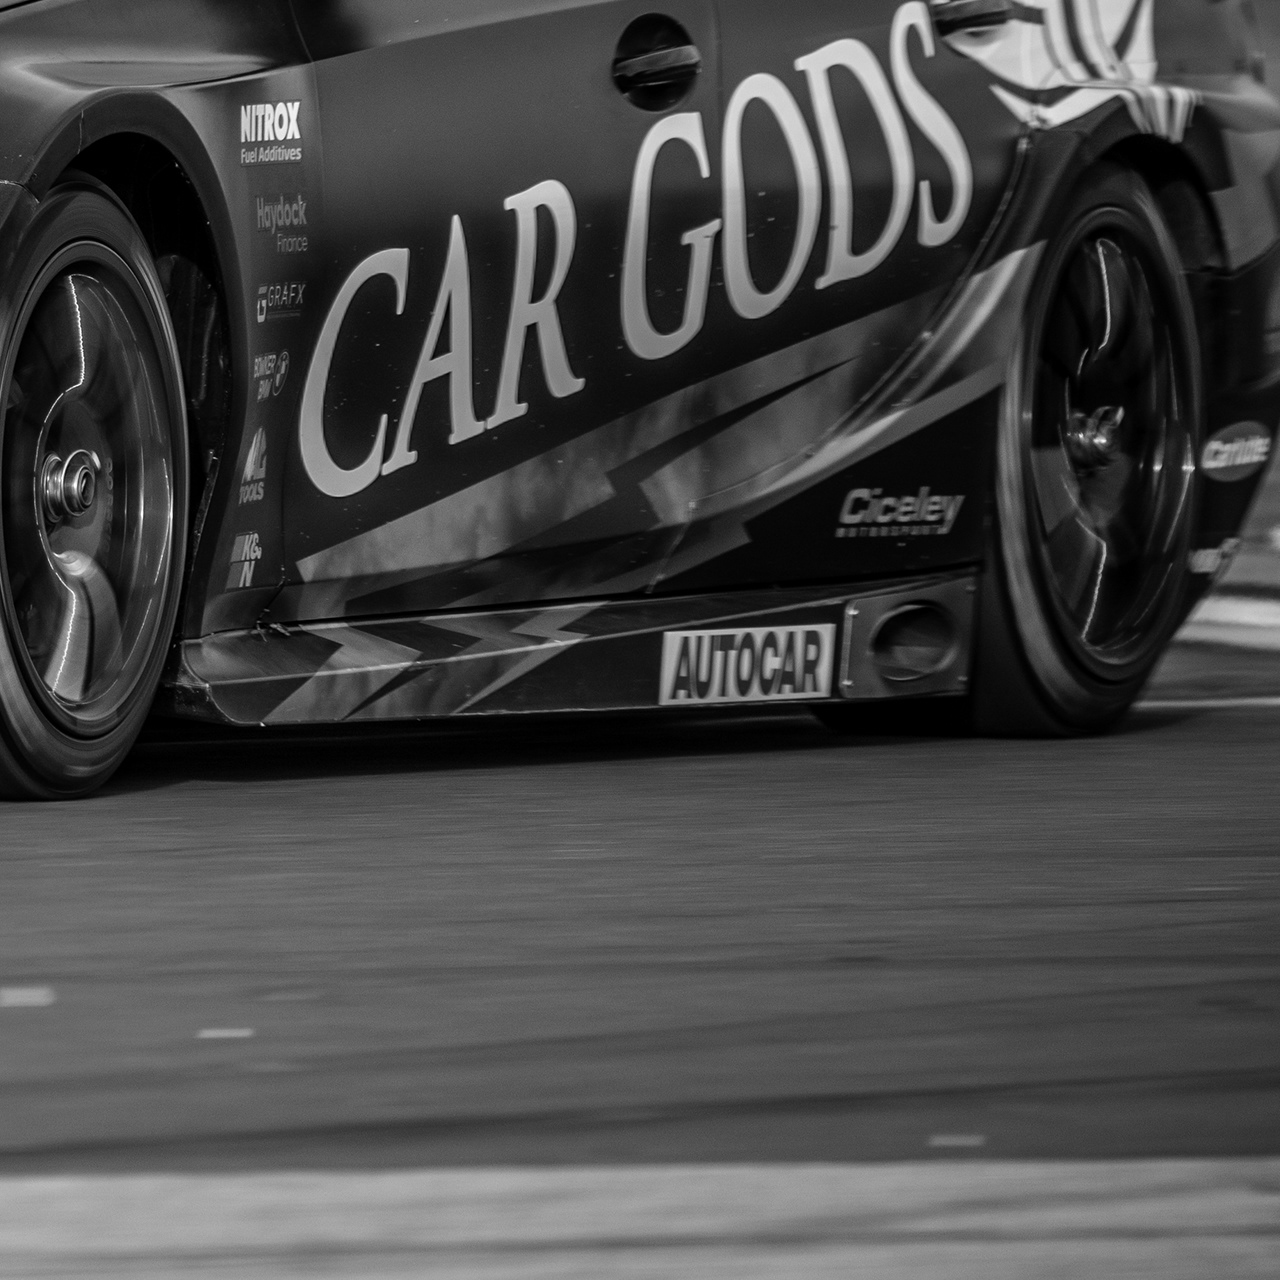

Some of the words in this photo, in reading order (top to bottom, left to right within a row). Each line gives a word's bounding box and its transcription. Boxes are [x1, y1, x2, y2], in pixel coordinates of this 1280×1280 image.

[240, 101, 301, 143] NITROX
[240, 148, 257, 164] Fuel
[258, 145, 302, 162] Additives
[256, 193, 308, 235] Haydock
[276, 233, 308, 253] Finance
[298, 179, 586, 497] CAR
[621, 0, 974, 361] GODS
[267, 283, 306, 308] GRAFX
[238, 481, 264, 505] TOOLS
[839, 485, 966, 535] Ciceley
[669, 629, 822, 700] AUTOCAR
